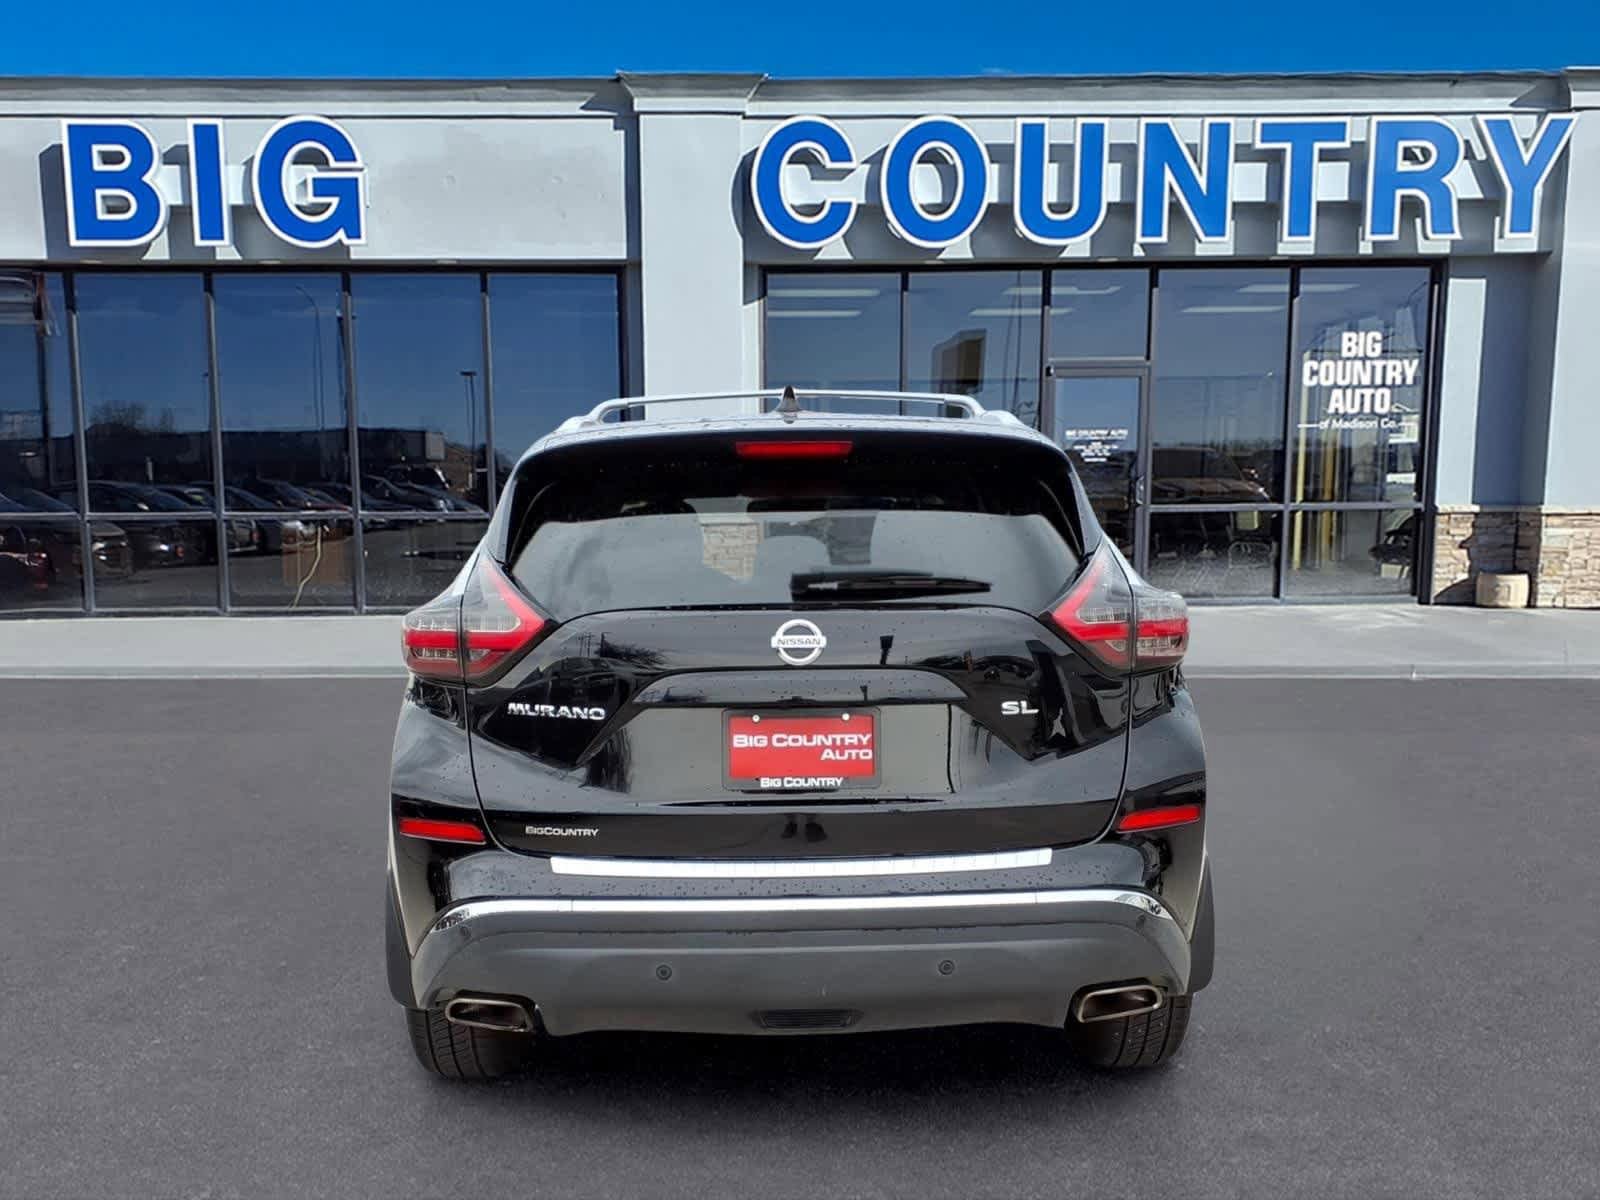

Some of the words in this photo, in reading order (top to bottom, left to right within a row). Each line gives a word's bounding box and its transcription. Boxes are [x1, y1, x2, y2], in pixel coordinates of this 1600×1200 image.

[61, 115, 368, 248] BIG
[750, 112, 1576, 248] COUNTRY
[1341, 331, 1382, 358] BIG
[1302, 359, 1419, 387] COUNTRY
[1327, 388, 1391, 414] AUTO
[1333, 418, 1378, 429] Madison
[777, 638, 821, 646] NISSAN
[507, 702, 606, 721] MURANO
[1001, 700, 1040, 715] SL
[733, 734, 768, 748] BIG
[771, 733, 872, 747] COUNTRY
[820, 749, 873, 760] AUTO
[760, 777, 782, 788] BIG
[783, 777, 844, 788] COUNTRY
